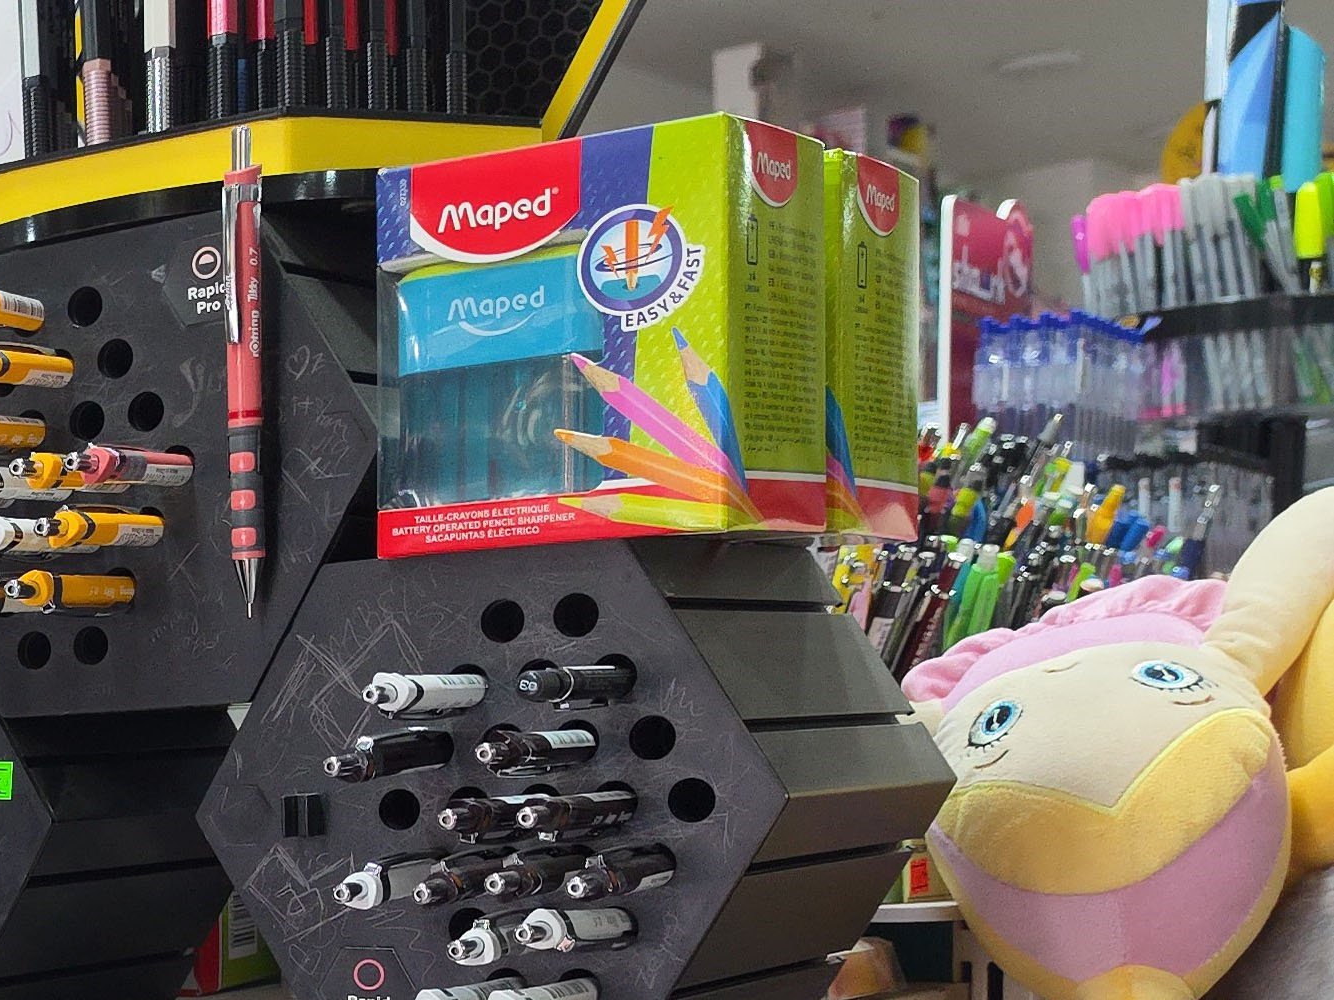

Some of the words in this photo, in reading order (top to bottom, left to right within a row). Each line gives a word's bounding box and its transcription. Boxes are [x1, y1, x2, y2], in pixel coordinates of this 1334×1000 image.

[757, 152, 791, 183] Maped
[437, 188, 551, 234] Maped
[866, 184, 895, 211] Maped
[625, 304, 671, 328] EASY
[678, 248, 702, 290] FAST
[197, 301, 221, 314] Pro
[447, 286, 545, 321] Maped
[392, 526, 431, 536] BATTERY
[433, 521, 480, 533] OPERATED
[483, 518, 516, 528] PENCIL
[518, 513, 575, 525] SHARPENER
[414, 510, 490, 523] TAILLE-CRAYONS
[425, 530, 485, 543] SACAPUNTAS
